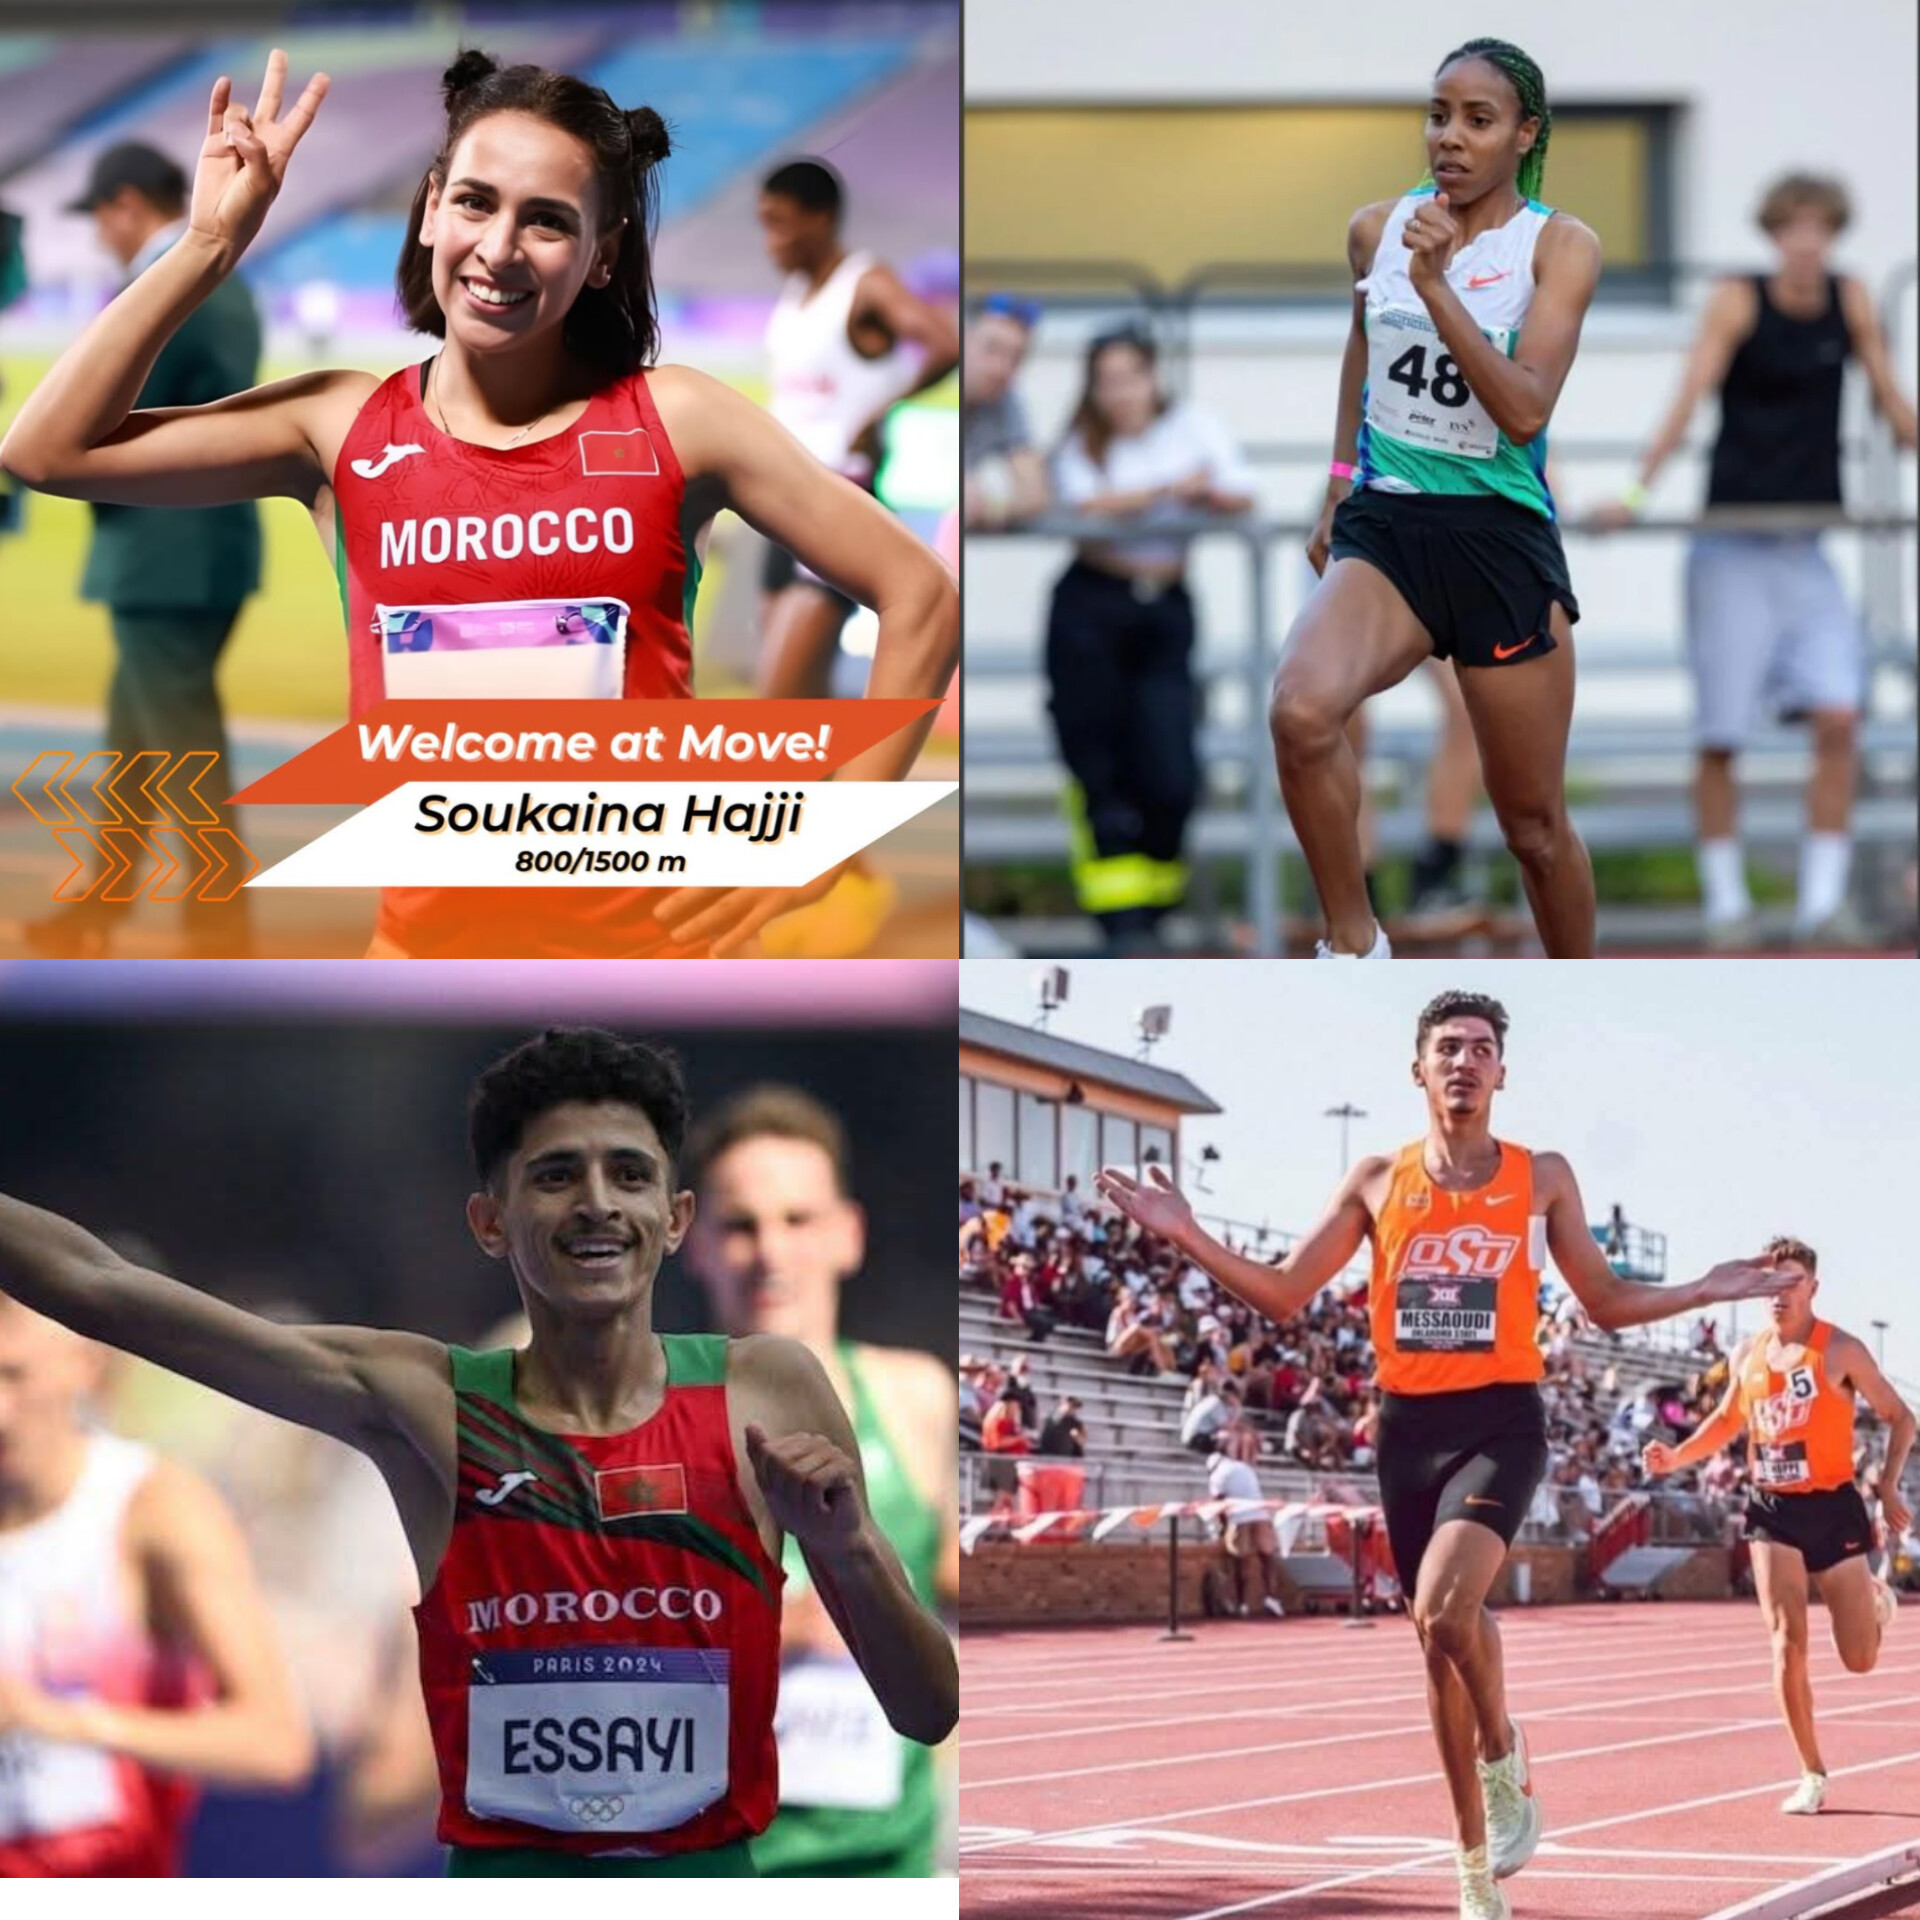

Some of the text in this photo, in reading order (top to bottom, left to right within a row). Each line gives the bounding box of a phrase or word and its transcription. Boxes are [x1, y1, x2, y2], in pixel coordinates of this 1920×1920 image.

[1387, 344, 1470, 408] 48
[380, 507, 634, 569] MOROCCO
[1398, 1224, 1521, 1278] OSU
[1401, 1311, 1490, 1330] MESSAOUDI
[1791, 1369, 1812, 1398] 5
[466, 1586, 722, 1634] MOROCCO
[533, 1655, 662, 1673] PARIS 2024
[503, 1716, 695, 1774] ESSAYI
